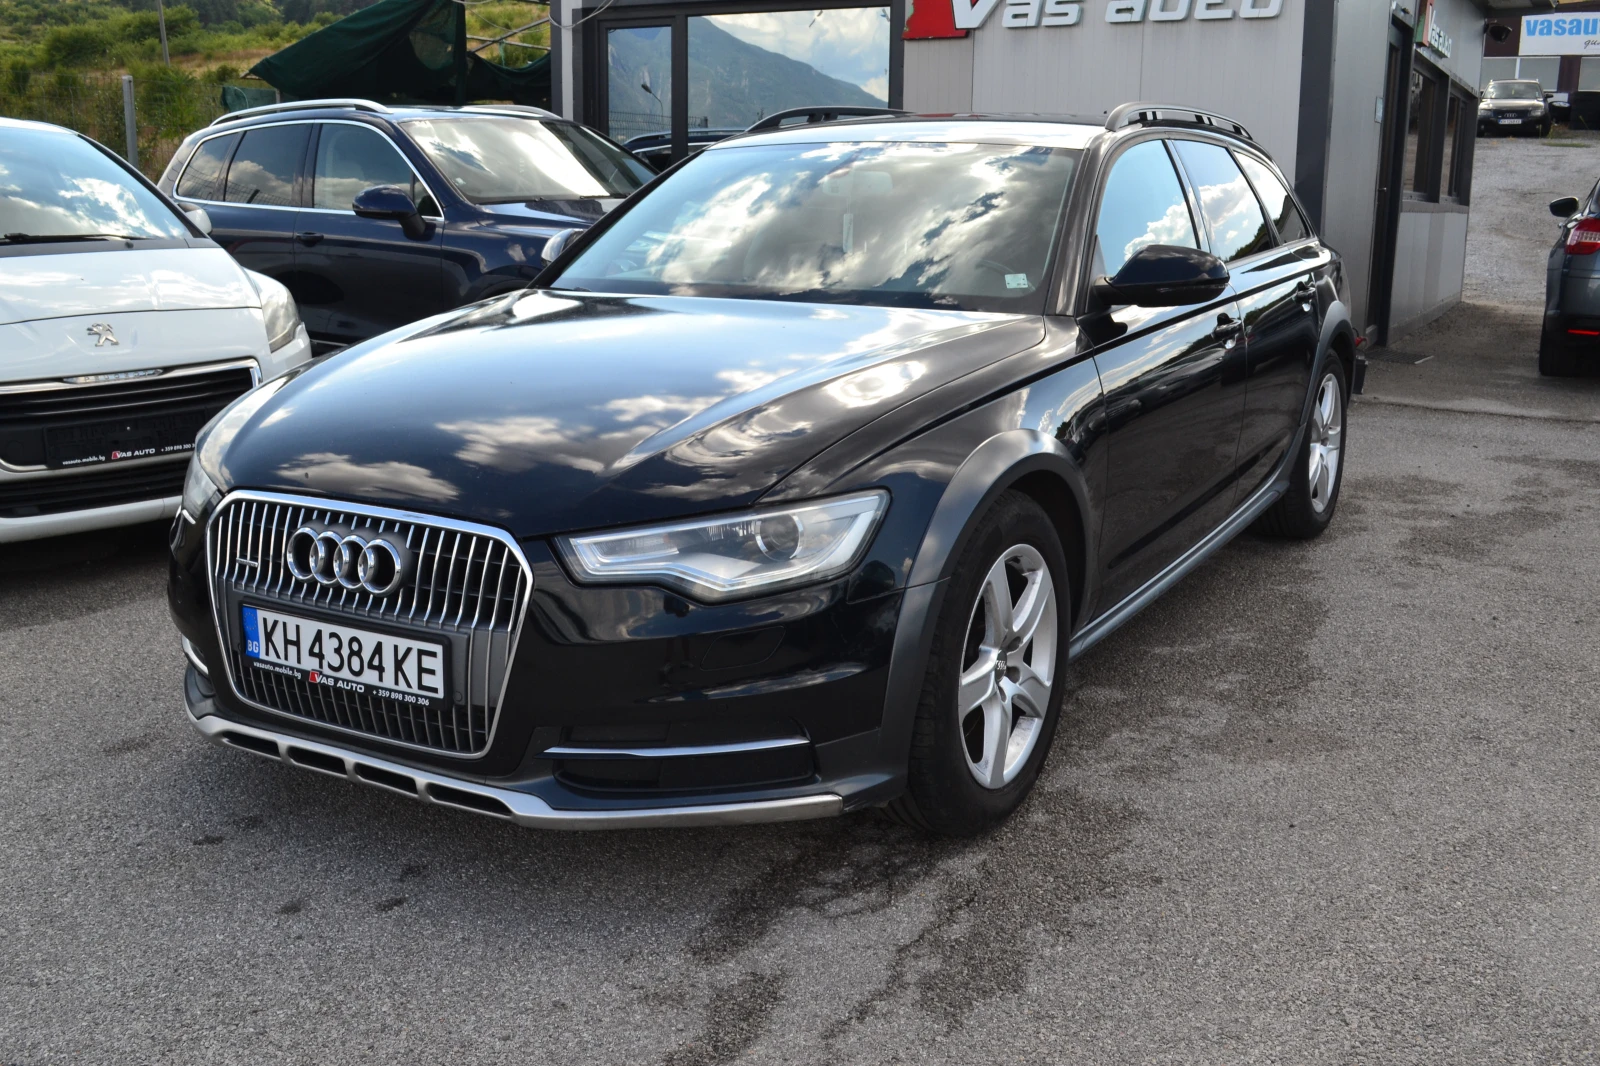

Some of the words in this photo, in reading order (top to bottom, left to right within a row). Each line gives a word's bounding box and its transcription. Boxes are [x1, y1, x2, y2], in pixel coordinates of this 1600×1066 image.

[1525, 17, 1600, 36] vasau
[134, 448, 155, 457] AUTO
[247, 639, 259, 653] BG
[253, 661, 302, 679] vasauto.mobile.bg
[315, 673, 335, 686] VAS
[336, 680, 365, 693] AUTO
[390, 692, 403, 701] 898
[404, 694, 416, 703] 300
[417, 697, 430, 706] 306
